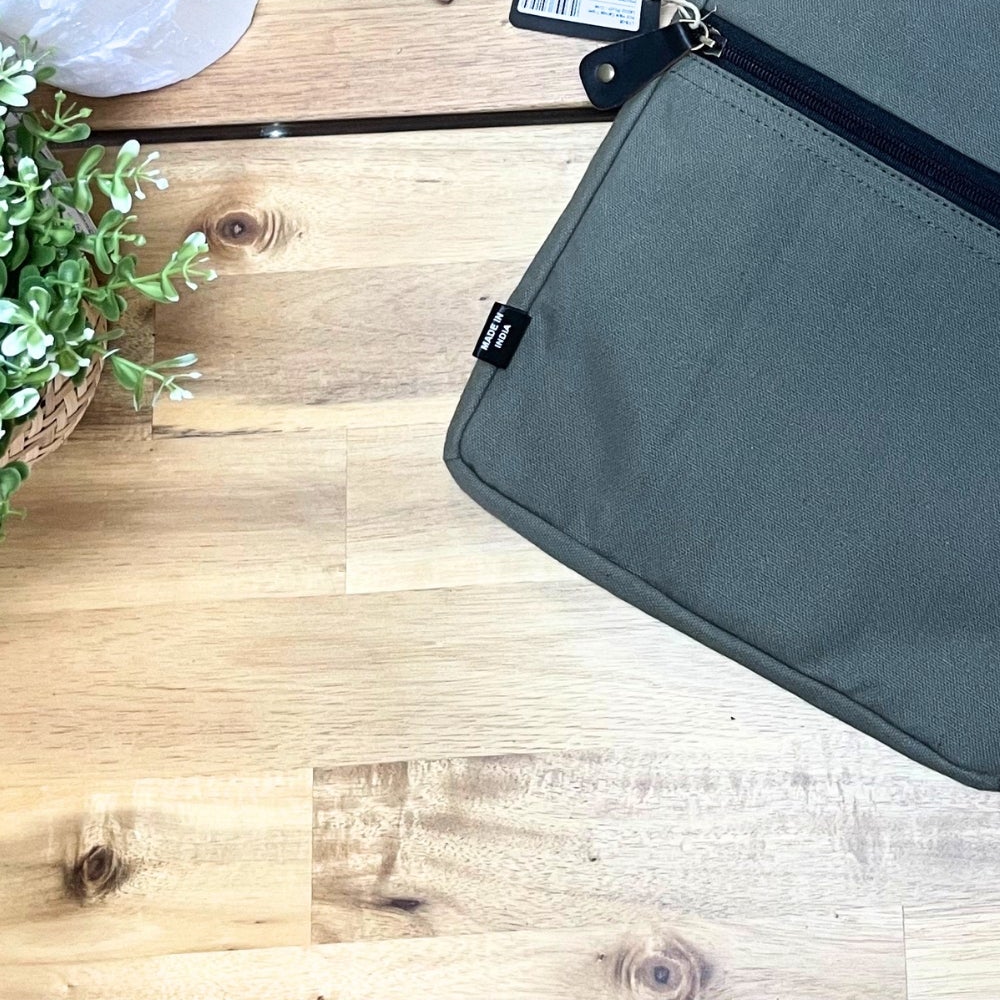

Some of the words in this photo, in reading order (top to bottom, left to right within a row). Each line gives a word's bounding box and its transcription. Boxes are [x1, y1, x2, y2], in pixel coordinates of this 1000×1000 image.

[480, 322, 499, 350] MADE
[493, 312, 504, 323] IN
[494, 324, 512, 348] INDIA
